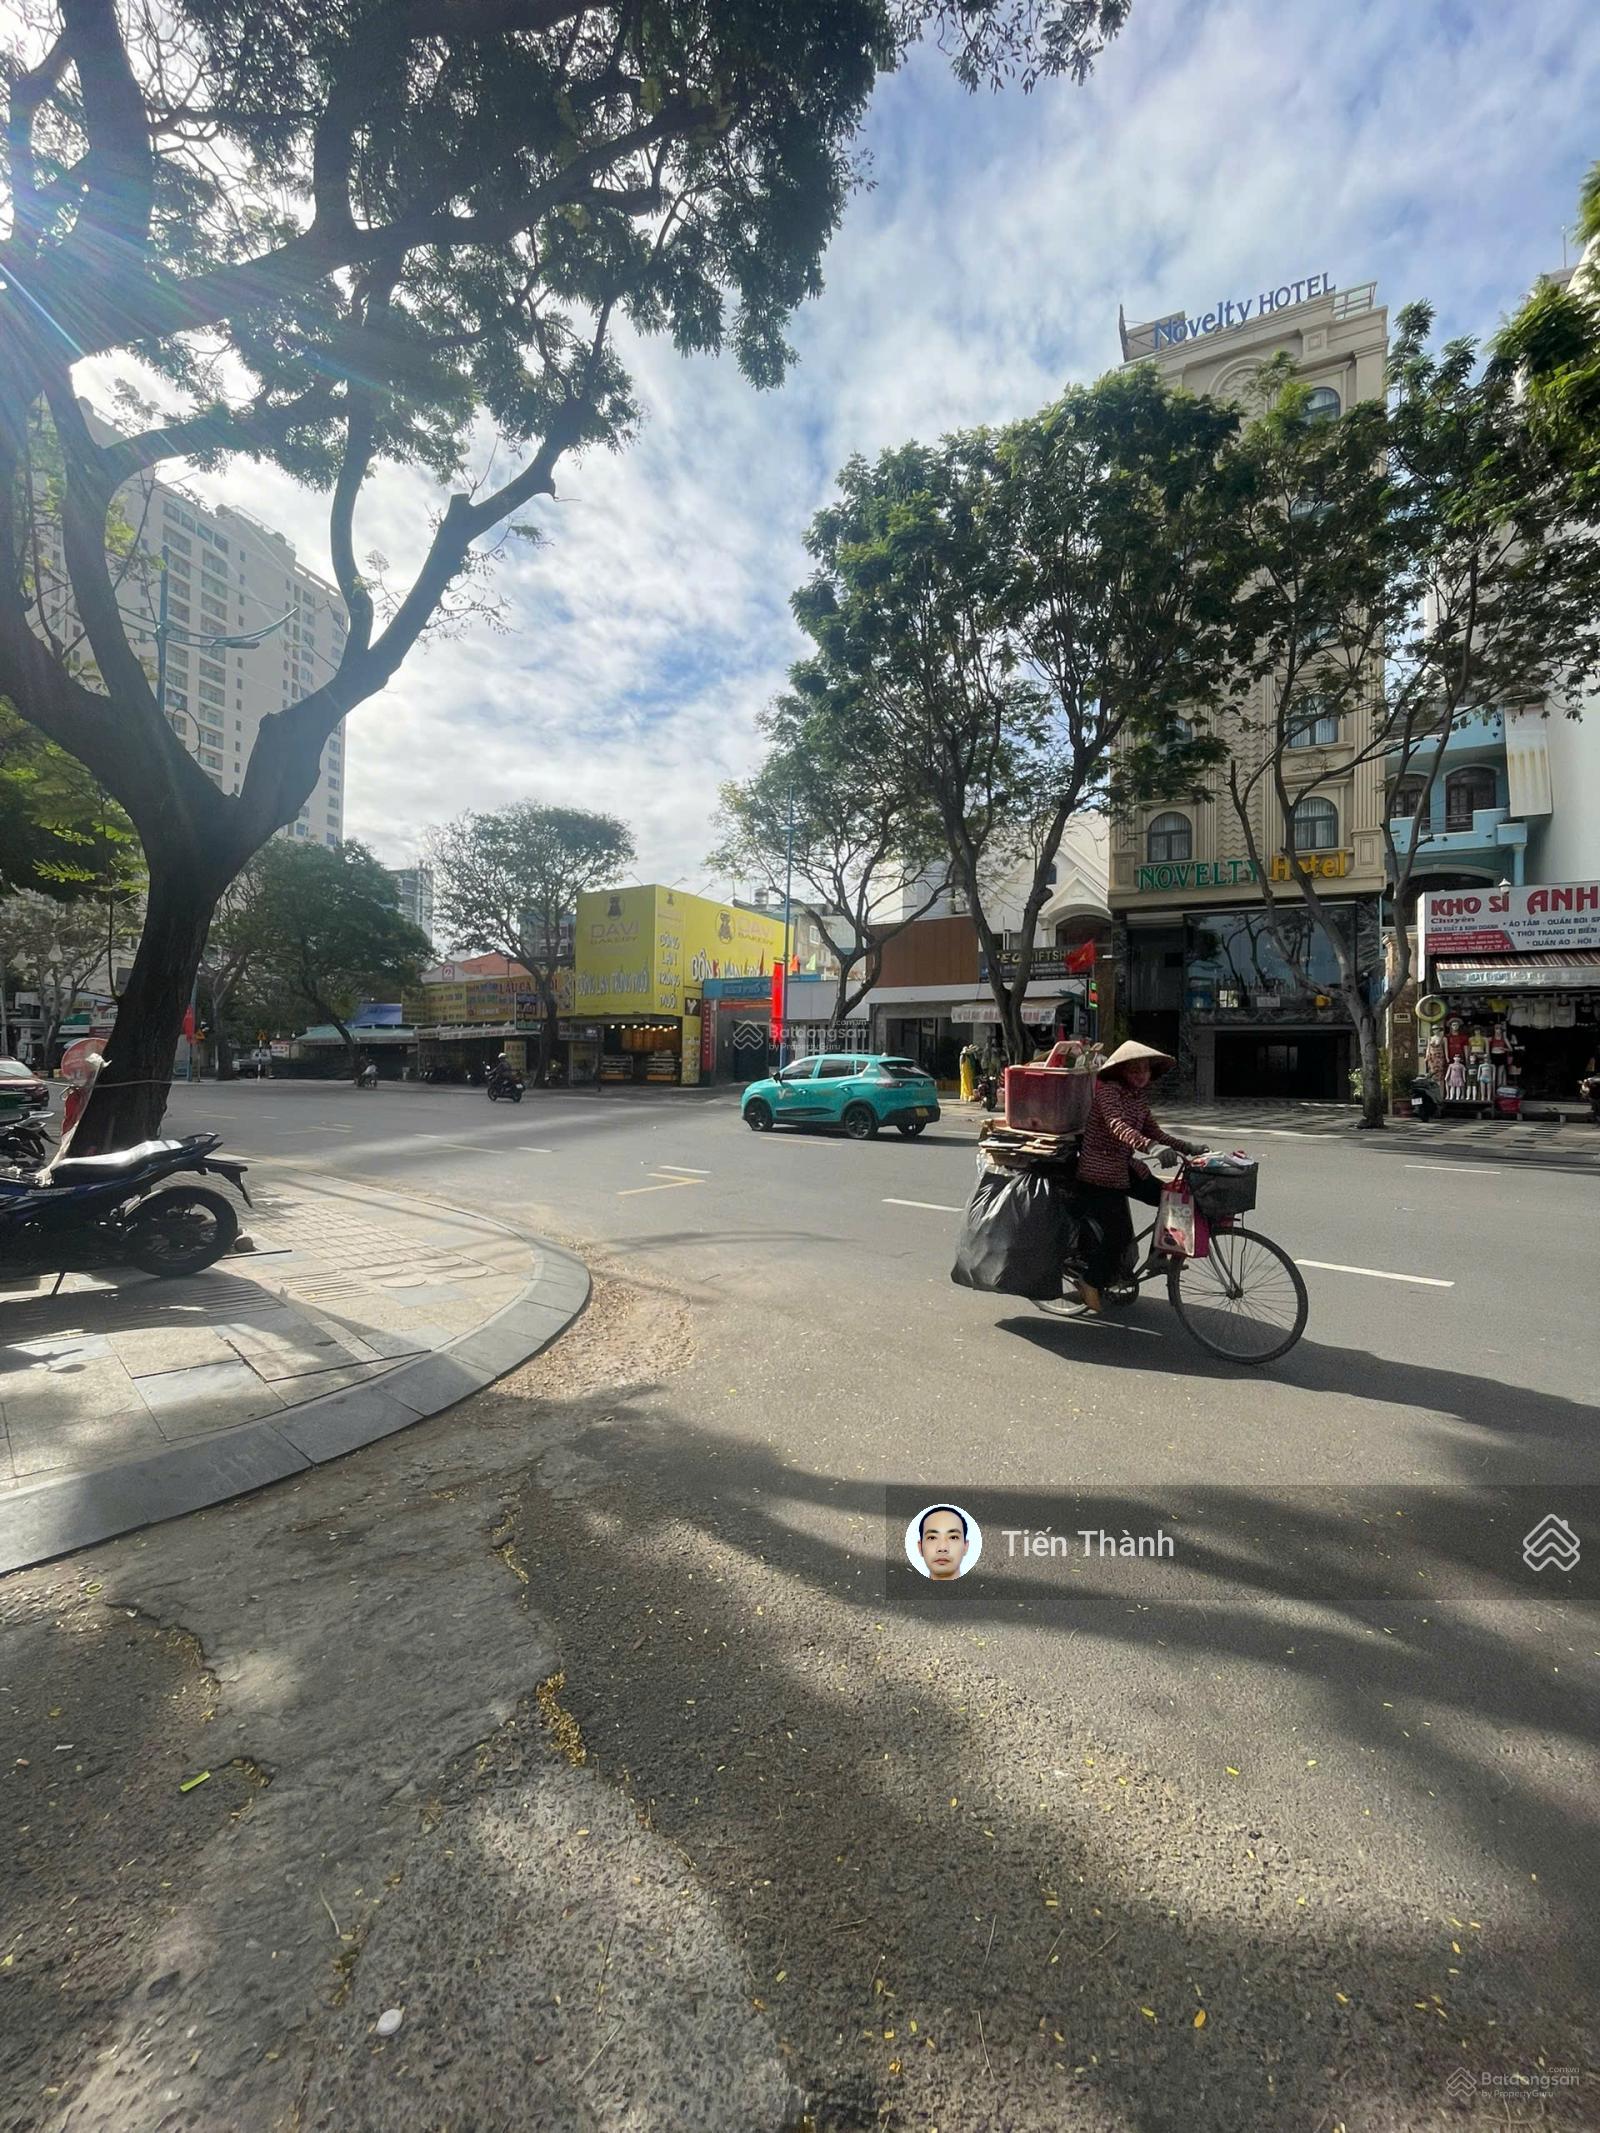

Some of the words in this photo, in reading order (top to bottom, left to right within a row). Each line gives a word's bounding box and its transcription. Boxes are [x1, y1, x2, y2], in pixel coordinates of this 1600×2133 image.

[1154, 298, 1253, 352] Novelty
[1259, 272, 1336, 316] HOTEL
[1137, 859, 1263, 891] NOVELTY
[1431, 897, 1481, 916] KHO
[1527, 885, 1599, 915] ANH
[590, 920, 640, 938] DAVI
[1537, 928, 1565, 936] TRANG
